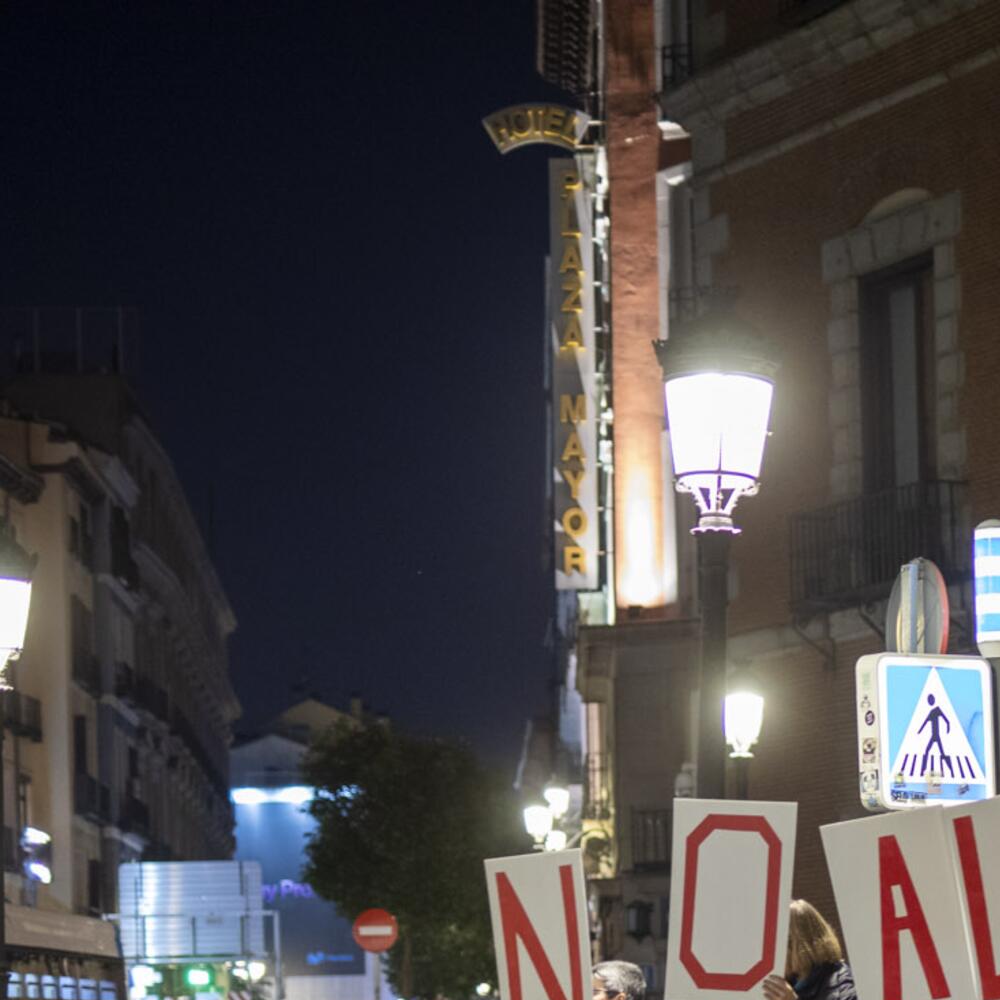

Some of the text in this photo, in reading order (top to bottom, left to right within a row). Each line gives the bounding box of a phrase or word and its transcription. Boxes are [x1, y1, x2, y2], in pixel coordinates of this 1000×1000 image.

[491, 106, 581, 147] HOTEL
[558, 170, 588, 576] PLAZA MAYOR
